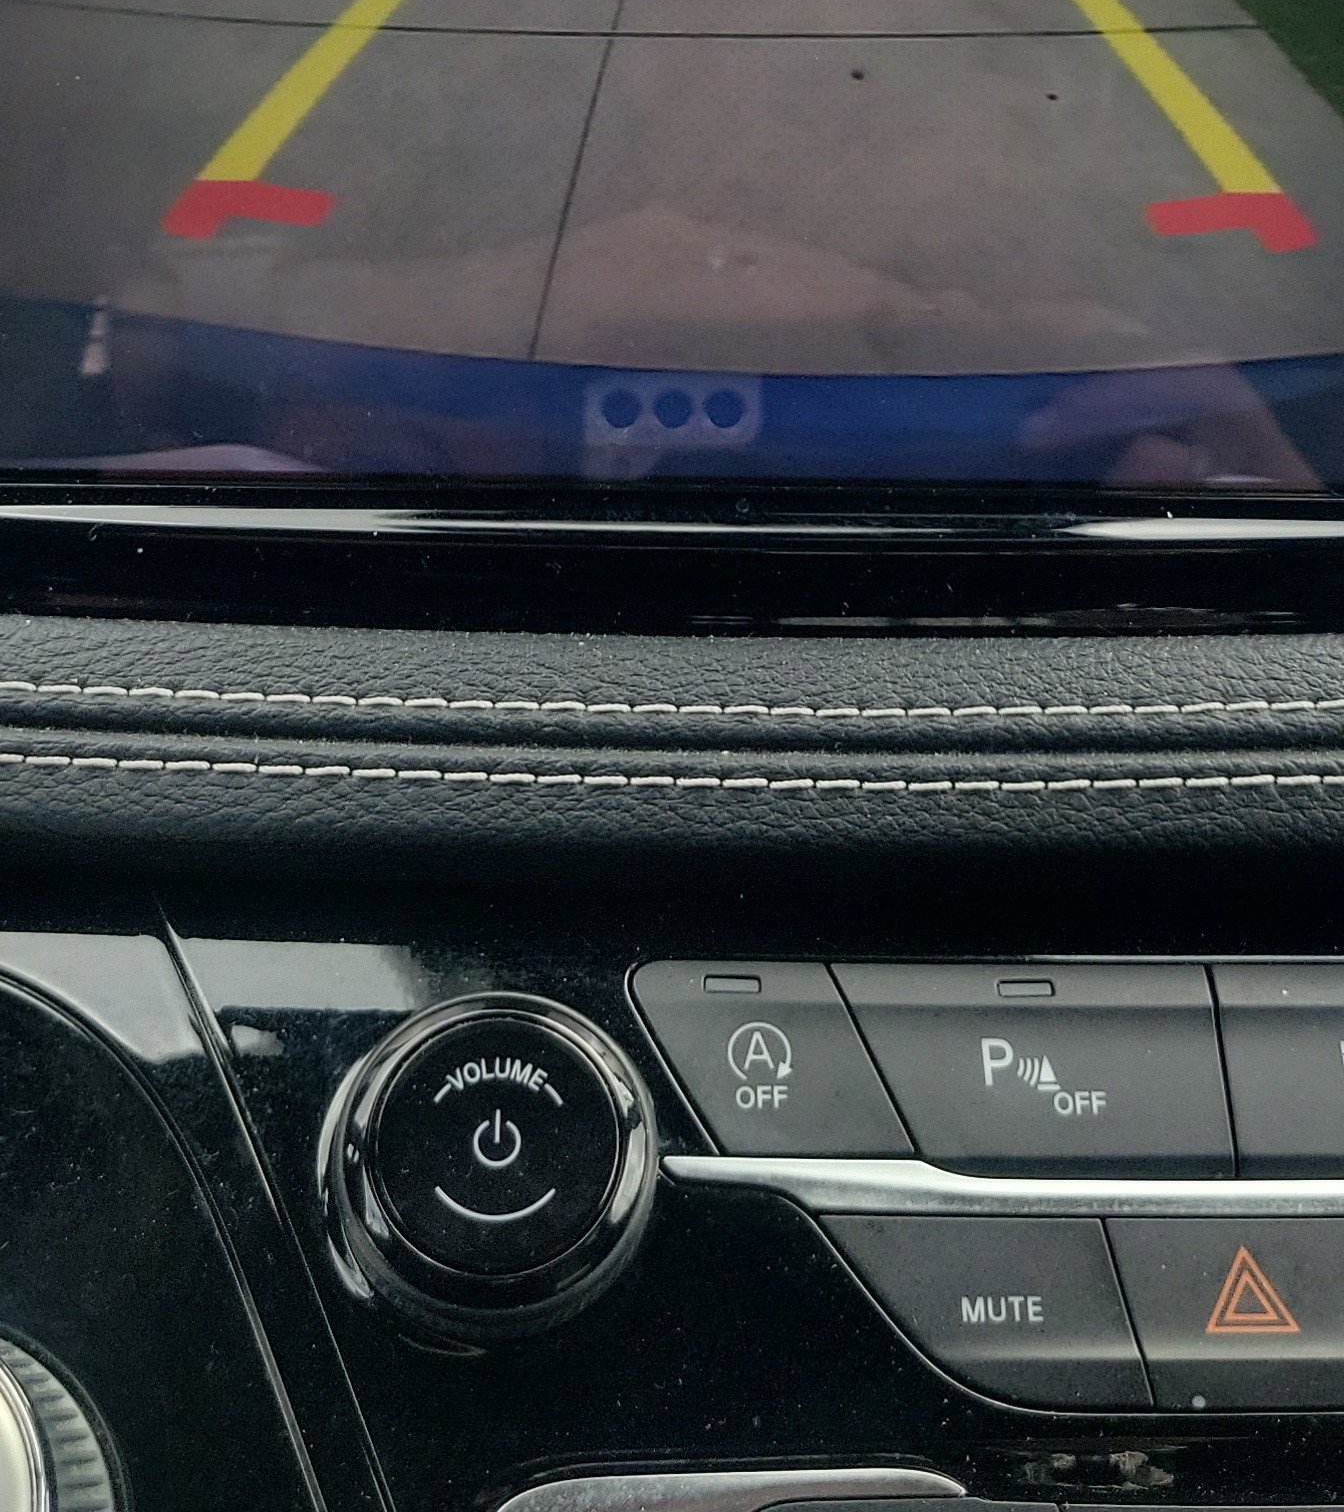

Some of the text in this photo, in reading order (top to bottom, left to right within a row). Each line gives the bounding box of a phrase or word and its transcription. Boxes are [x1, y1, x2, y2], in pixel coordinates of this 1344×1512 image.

[445, 1056, 549, 1092] VOLUME
[980, 1037, 1014, 1088] P
[735, 1085, 789, 1109] OFF
[1052, 1090, 1108, 1116] OFF
[960, 1294, 1045, 1324] MUTE
